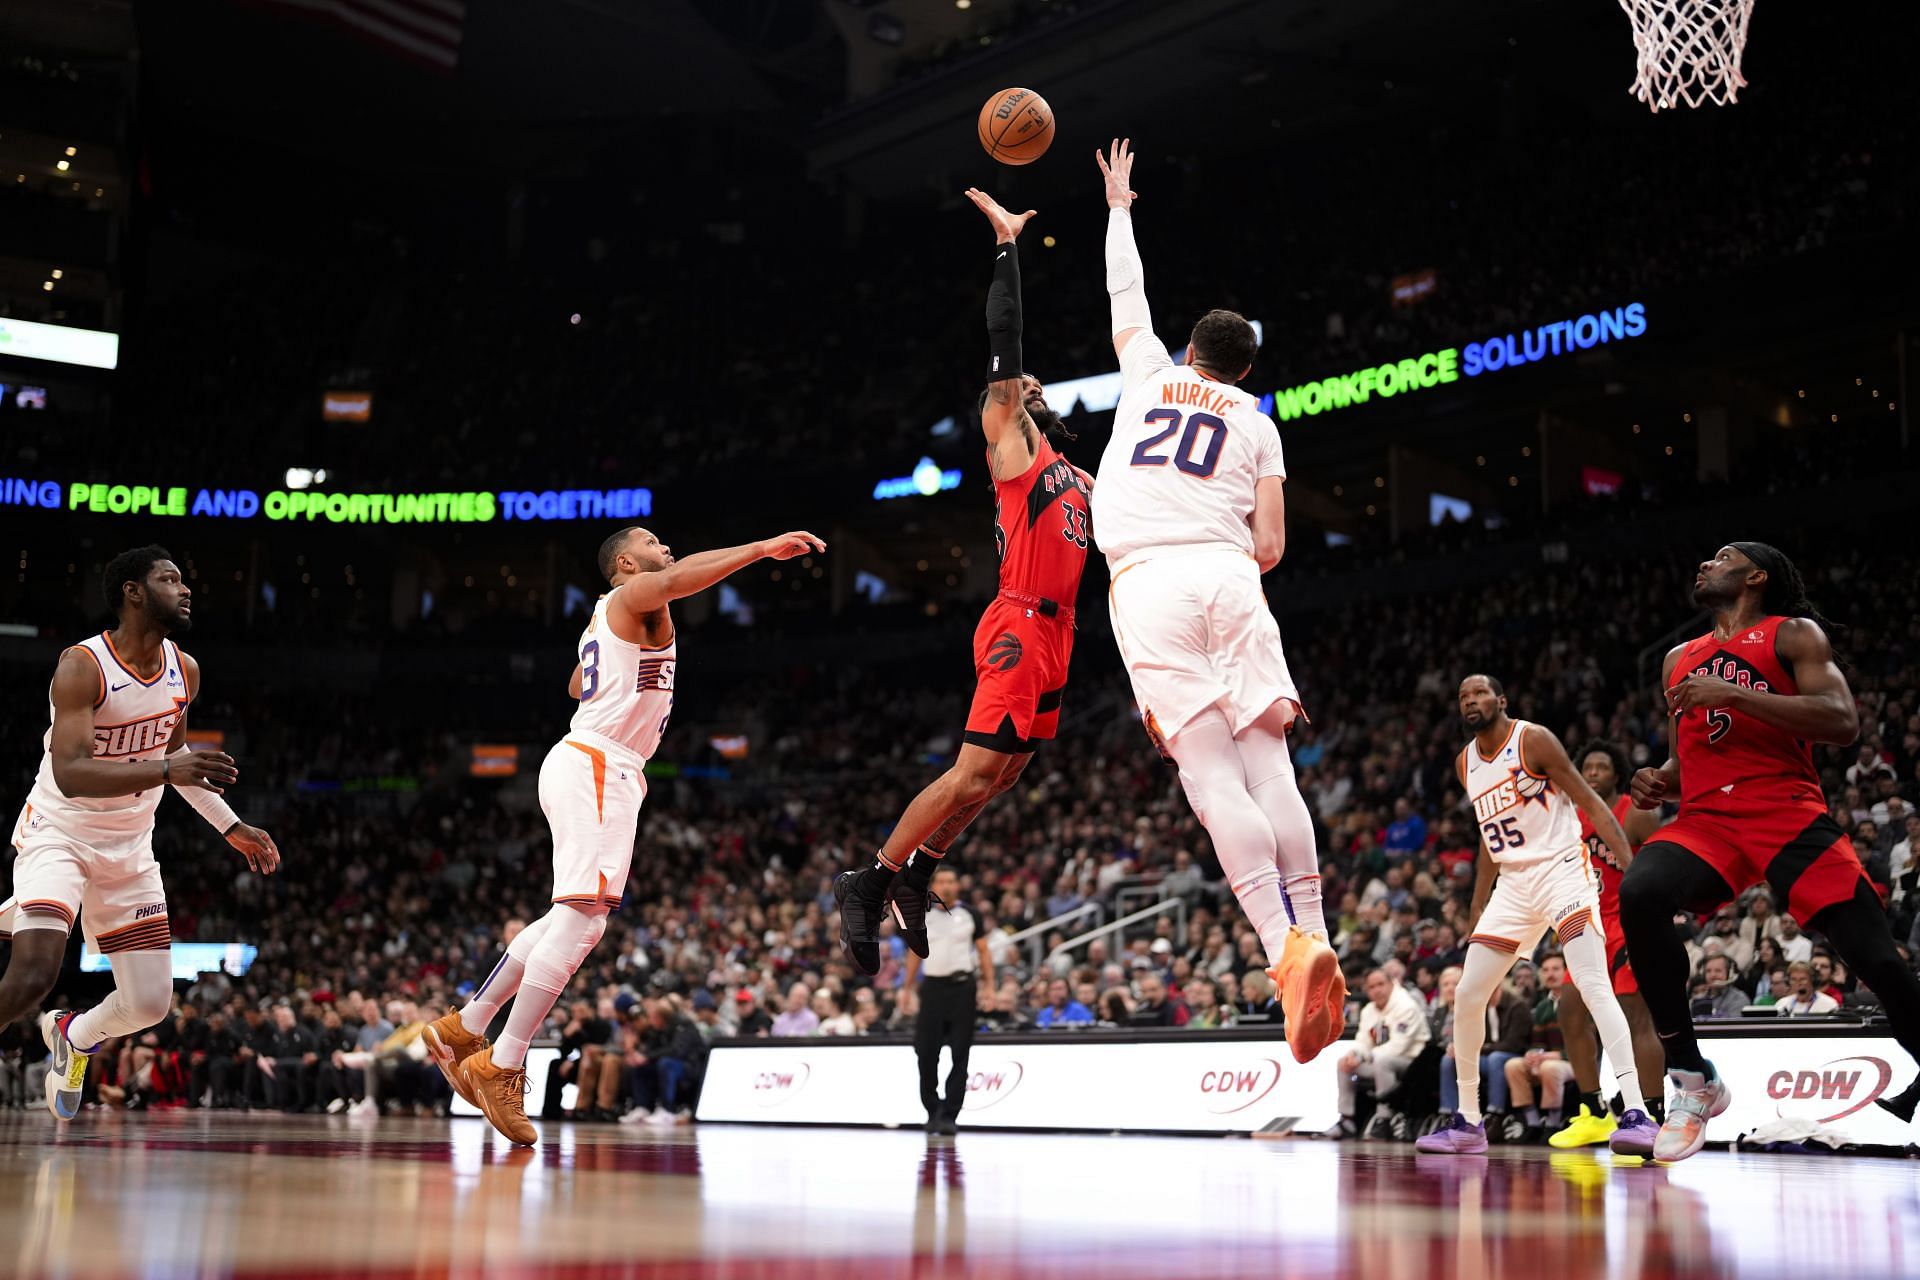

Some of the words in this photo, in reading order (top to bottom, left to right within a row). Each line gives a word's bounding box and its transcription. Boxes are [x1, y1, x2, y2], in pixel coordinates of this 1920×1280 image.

[1275, 348, 1458, 421] WORKFORCE
[1463, 302, 1647, 376] SOLUTIONS
[1130, 408, 1228, 480] 20
[0, 477, 62, 509] ING
[69, 482, 187, 516] PEOPLE
[192, 488, 259, 518] AND
[264, 490, 495, 523] OPPORTUNITIES
[500, 488, 652, 520] TOGETHER
[1062, 500, 1088, 548] 33
[1707, 706, 1732, 744] 5
[1473, 779, 1517, 824] UNS
[1483, 816, 1526, 854] 35
[965, 1072, 1007, 1091] DW
[1200, 1070, 1261, 1093] CDW
[1766, 1070, 1862, 1100] CDW
